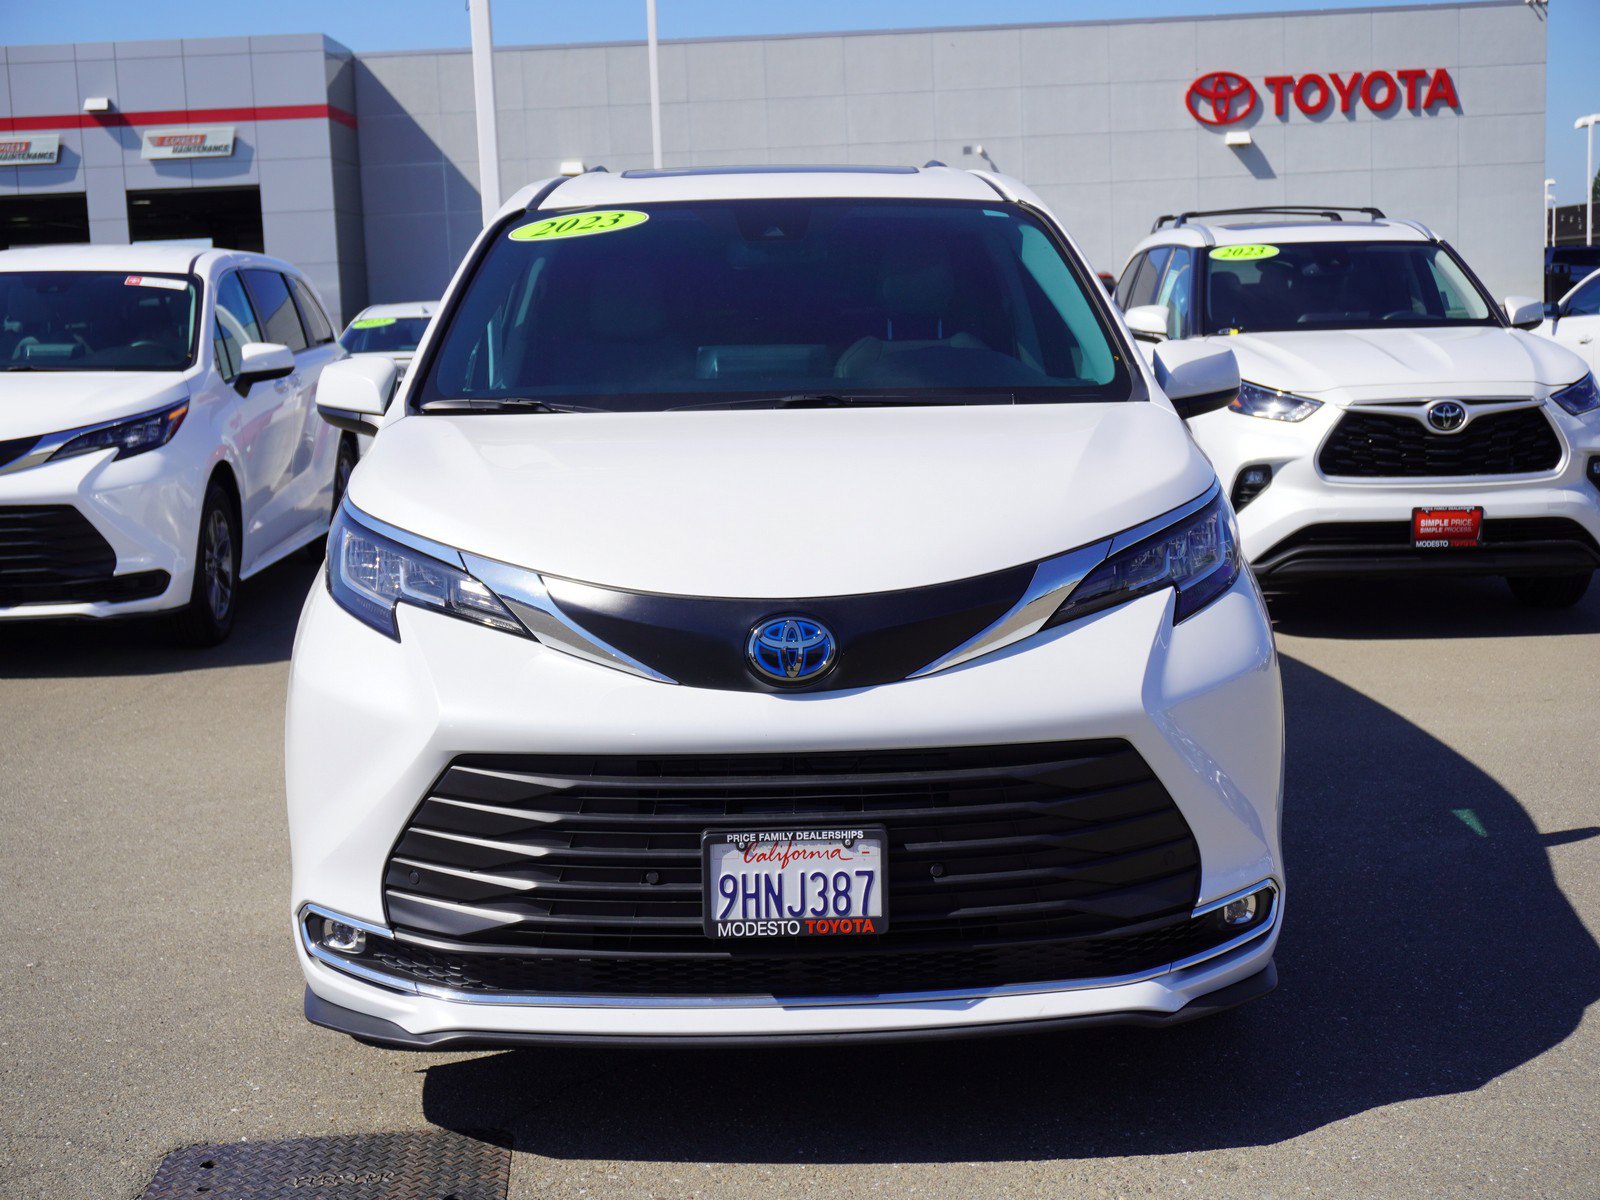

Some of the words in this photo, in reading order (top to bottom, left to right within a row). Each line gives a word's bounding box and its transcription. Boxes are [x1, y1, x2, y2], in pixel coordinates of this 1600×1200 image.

[1264, 68, 1459, 116] TOYOTA
[530, 213, 625, 237] 2023
[1221, 247, 1266, 257] 2023
[727, 833, 756, 843] PRICE
[758, 832, 793, 842] FAMILY
[796, 830, 864, 840] DEALERSHIPS
[743, 841, 853, 869] California
[719, 870, 874, 920] 9HNJ387
[717, 920, 800, 937] MODESTO
[805, 919, 875, 935] TOYOTA
